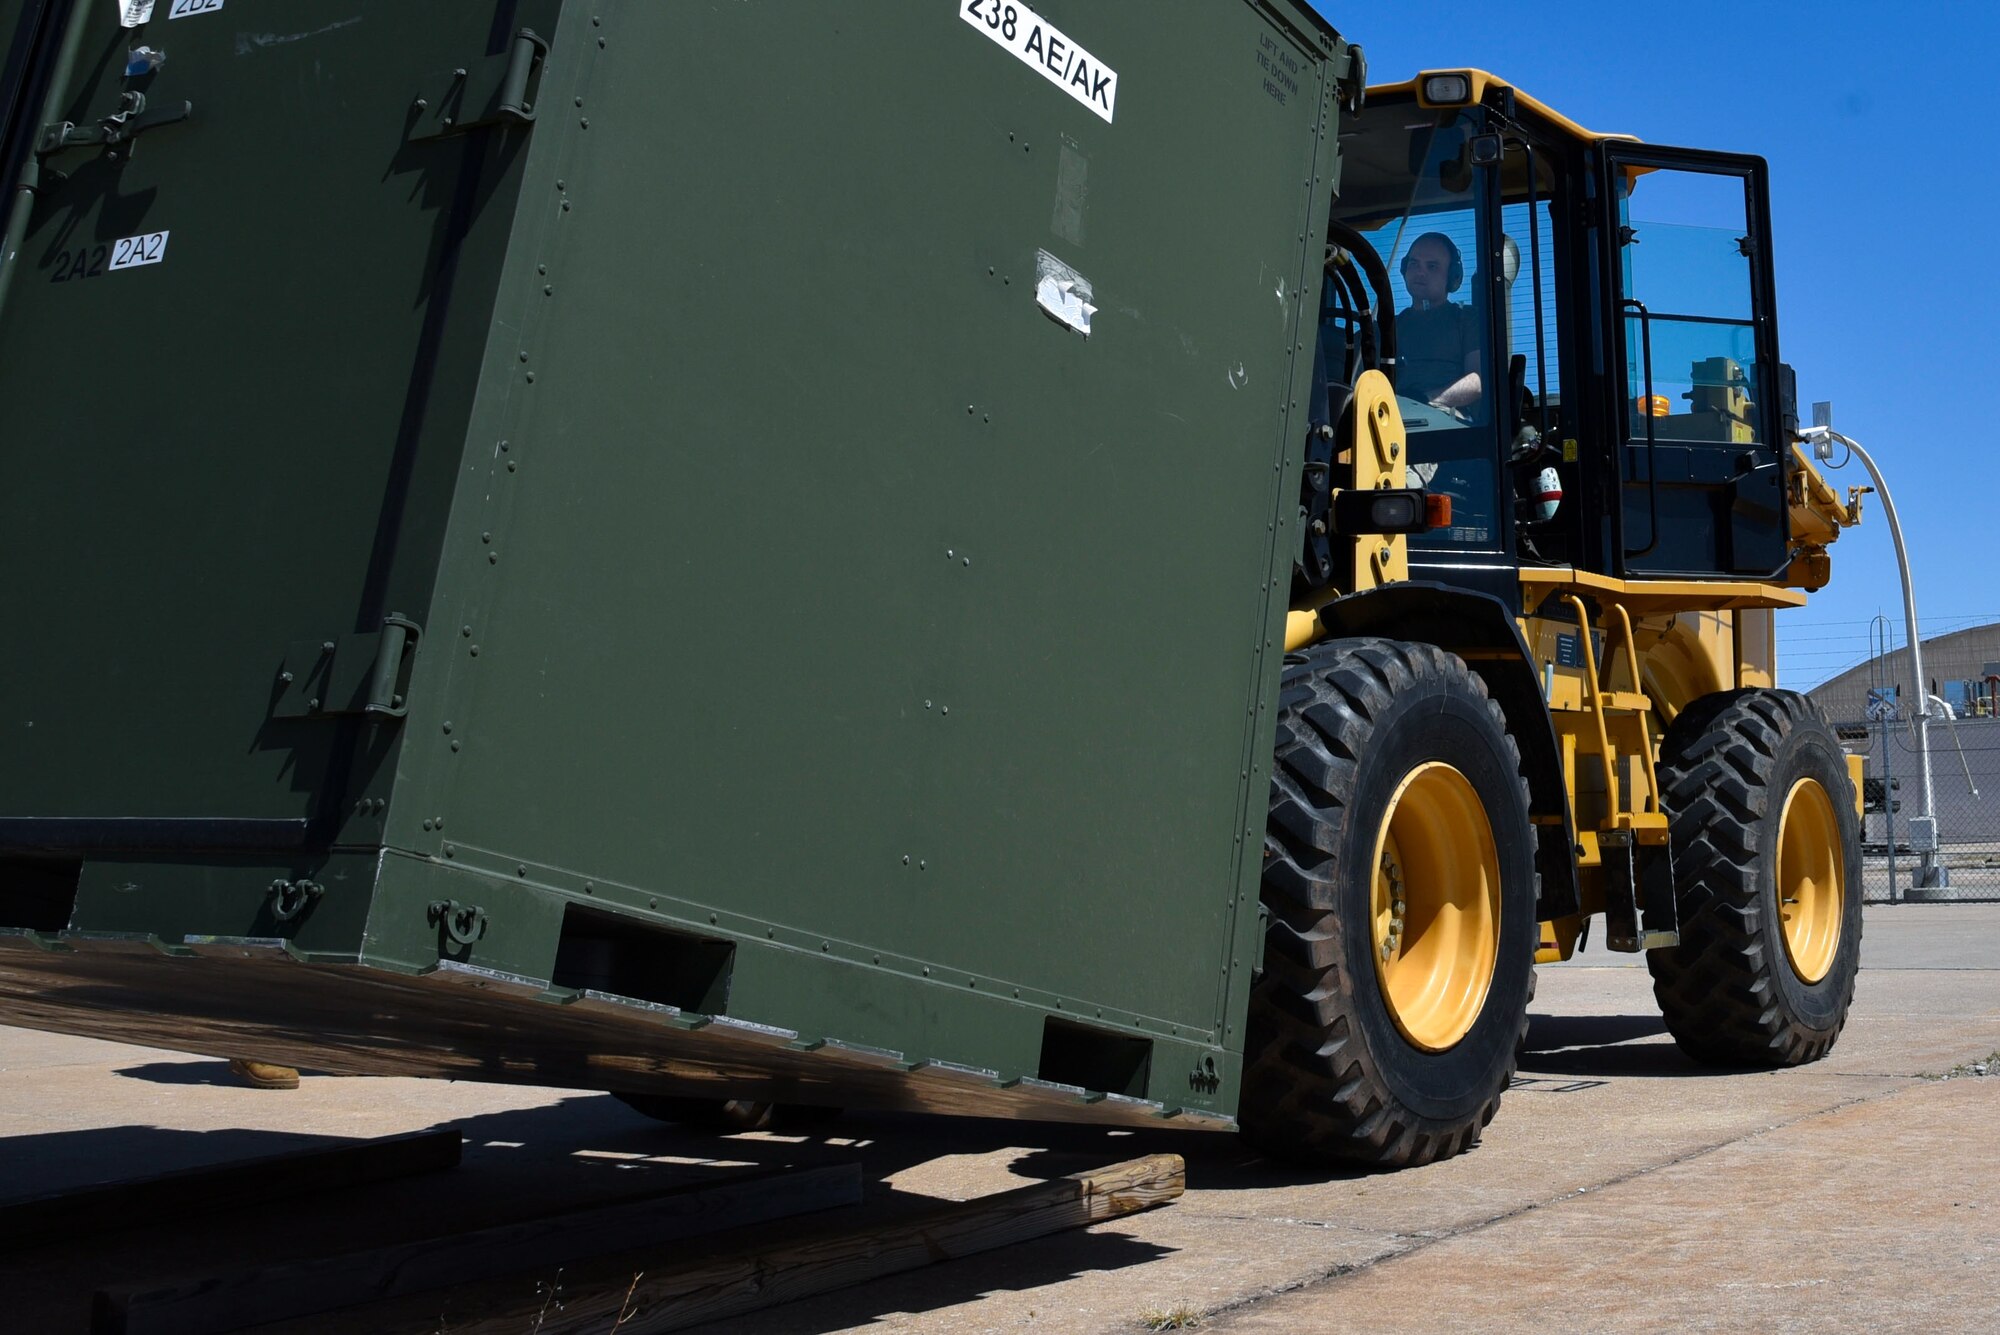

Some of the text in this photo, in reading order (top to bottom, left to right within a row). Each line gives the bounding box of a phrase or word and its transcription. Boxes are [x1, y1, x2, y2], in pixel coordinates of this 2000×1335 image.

[1024, 25, 1111, 111] AE/AK
[1256, 49, 1298, 95] TIE DOWN
[1260, 32, 1298, 74] LIFT AND
[1263, 77, 1287, 106] HERE
[50, 245, 107, 283] 2A2
[115, 233, 163, 265] 2A2
